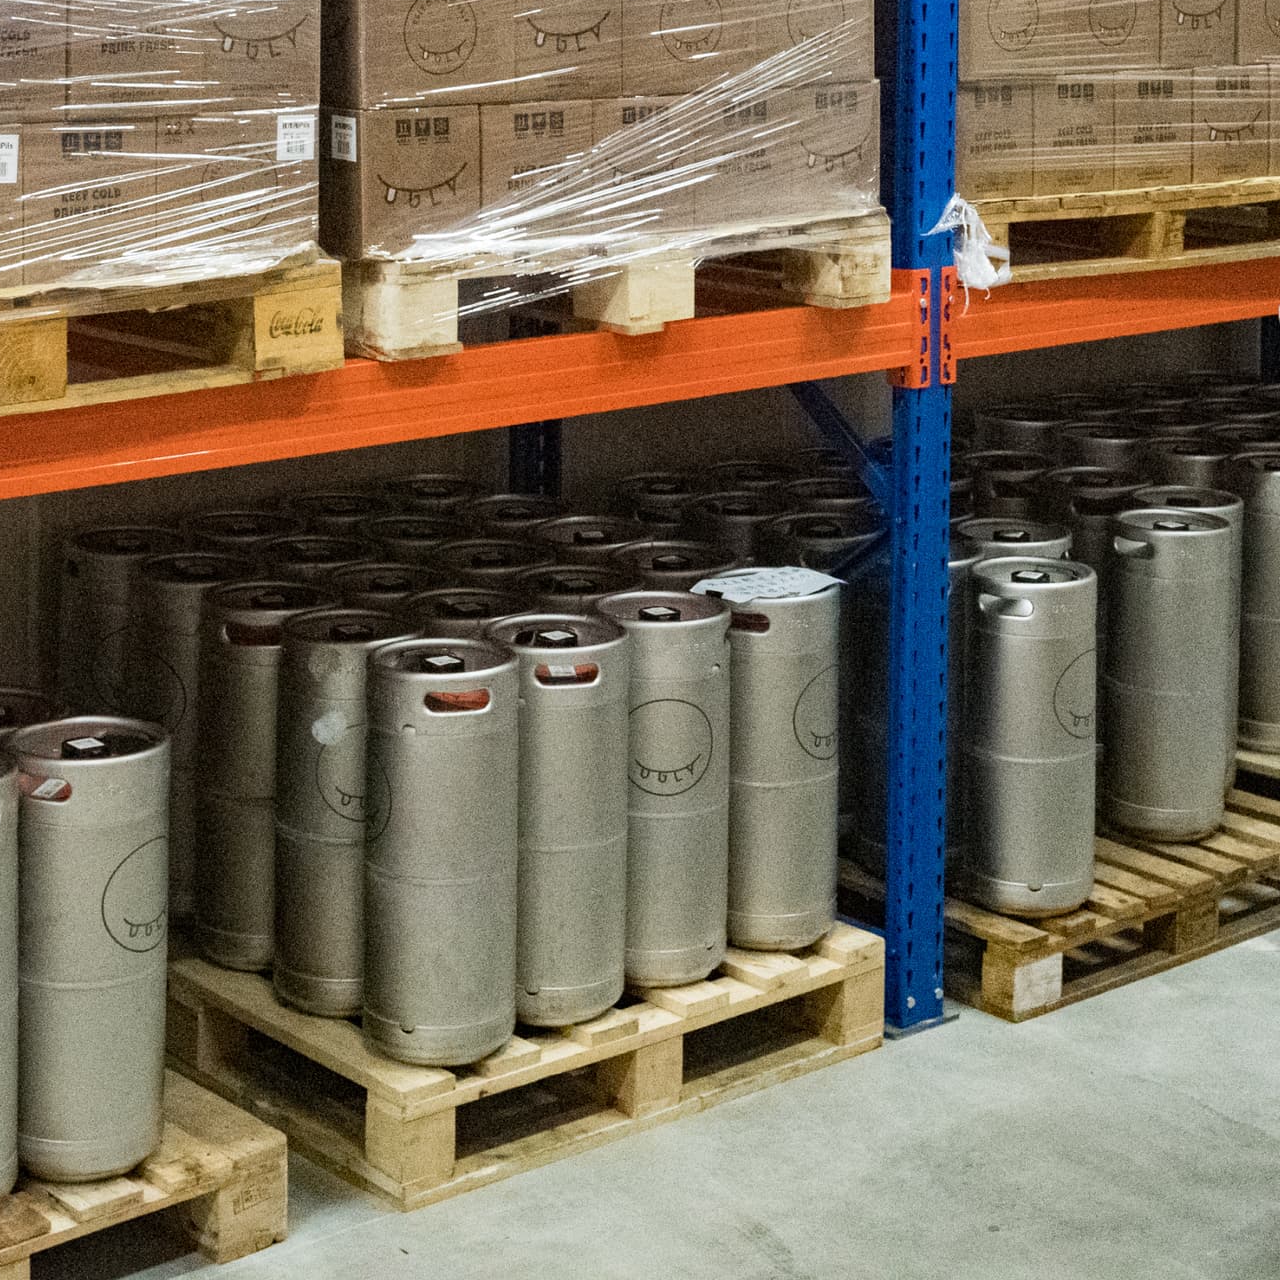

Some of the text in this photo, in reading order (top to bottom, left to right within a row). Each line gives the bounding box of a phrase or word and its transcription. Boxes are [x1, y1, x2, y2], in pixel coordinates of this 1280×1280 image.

[535, 29, 600, 53] UGLY
[385, 180, 457, 208] UGLY
[641, 764, 693, 782] UGLY
